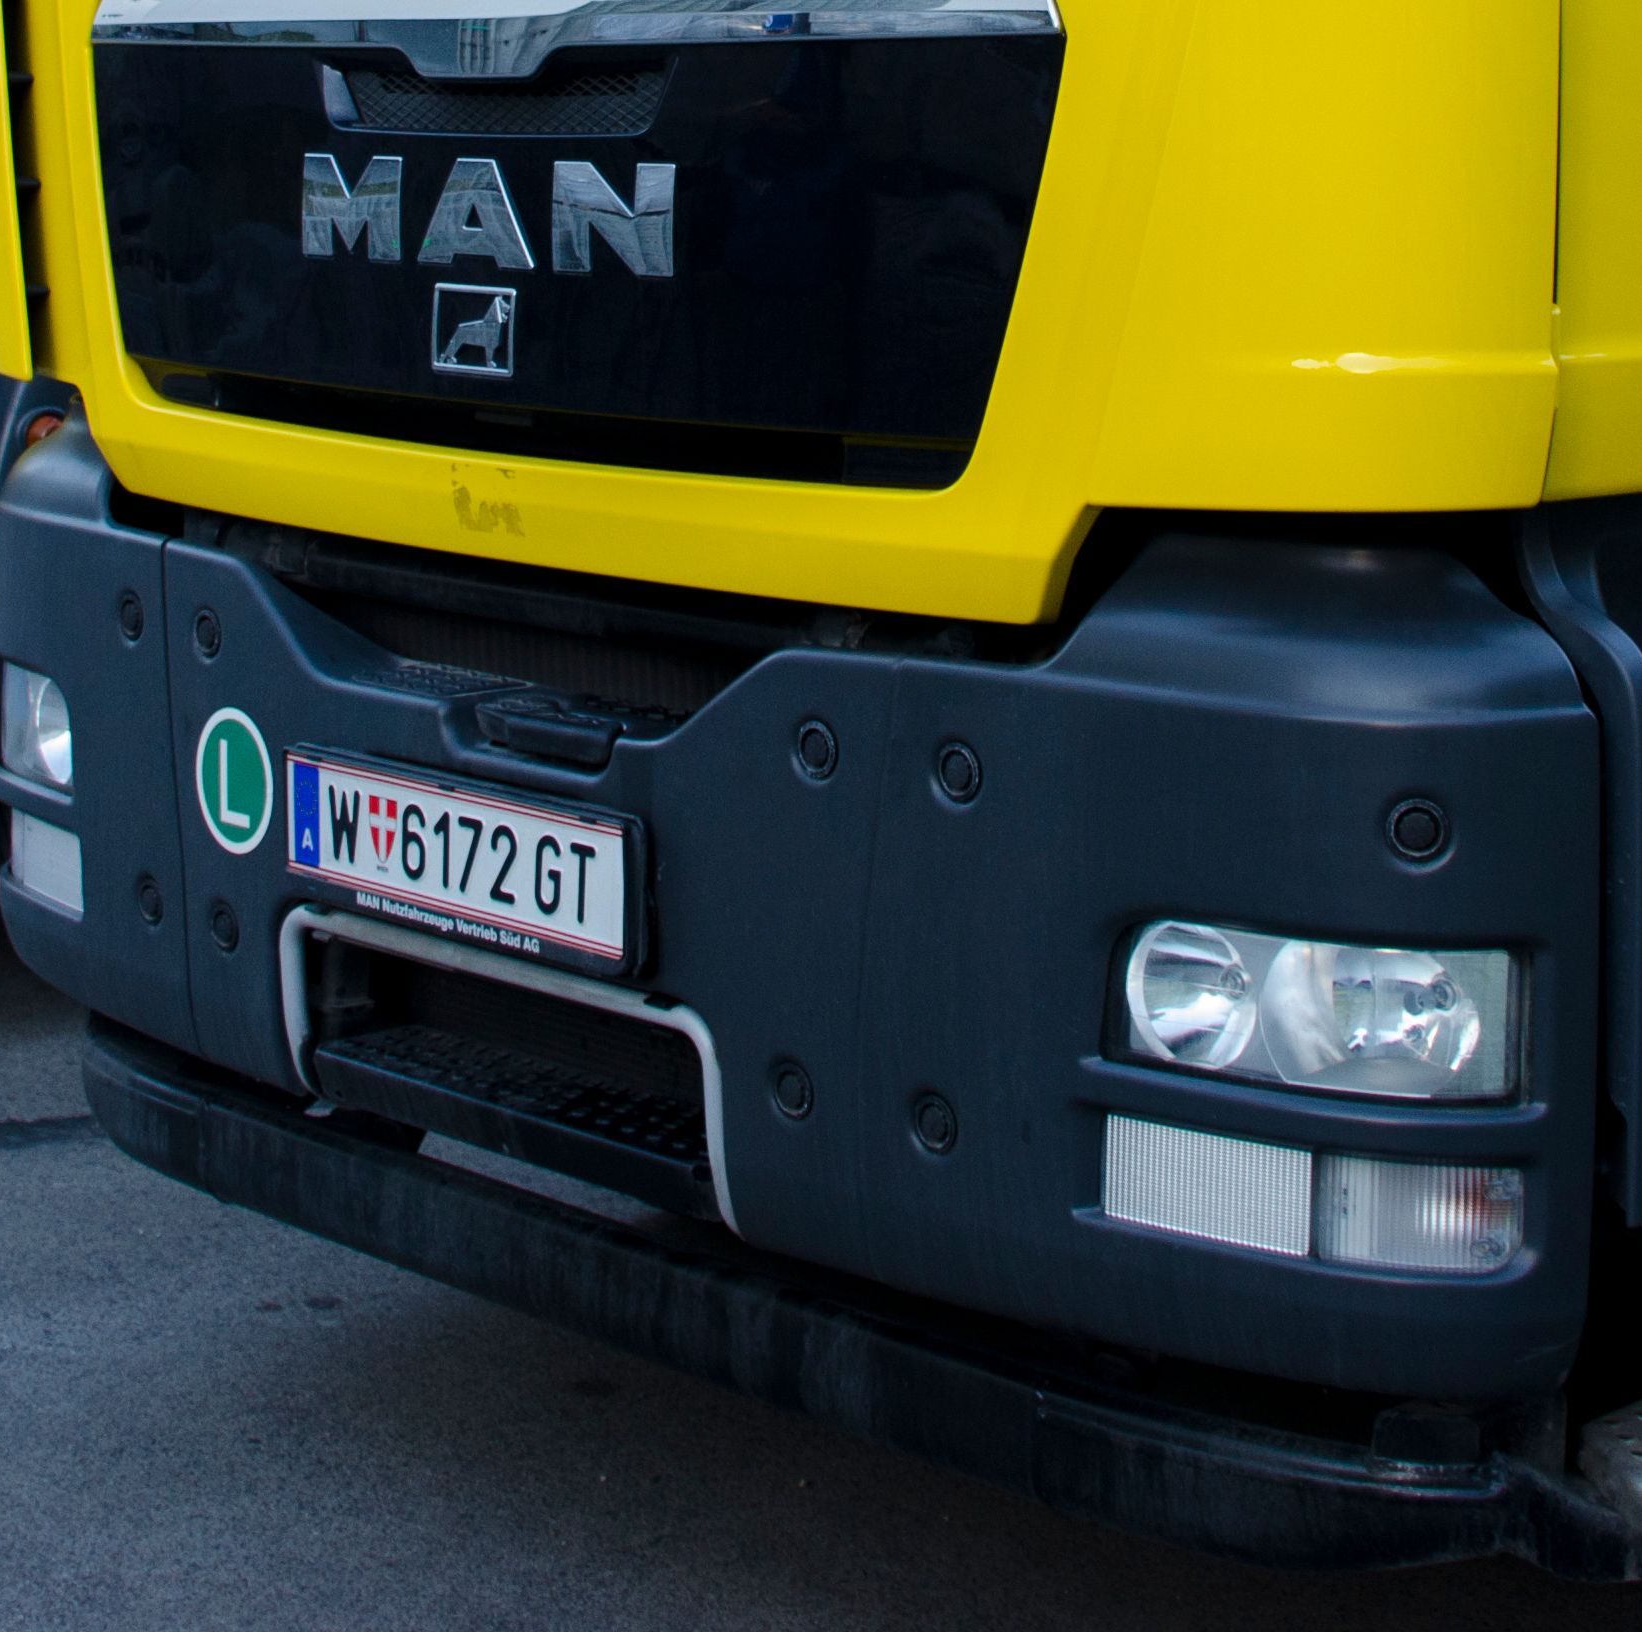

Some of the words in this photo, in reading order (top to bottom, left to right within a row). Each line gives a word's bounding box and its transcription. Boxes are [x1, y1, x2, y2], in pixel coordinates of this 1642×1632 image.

[302, 152, 676, 277] MAN
[218, 737, 251, 826] L
[301, 826, 314, 852] A
[328, 783, 361, 866] W
[400, 803, 519, 905] 6172
[534, 834, 597, 925] GT
[357, 891, 380, 911] MAN
[382, 898, 455, 932] Nutzfahrzeuge
[456, 917, 498, 942] Vertrieb
[499, 928, 521, 949] Süd
[523, 937, 541, 954] AG
